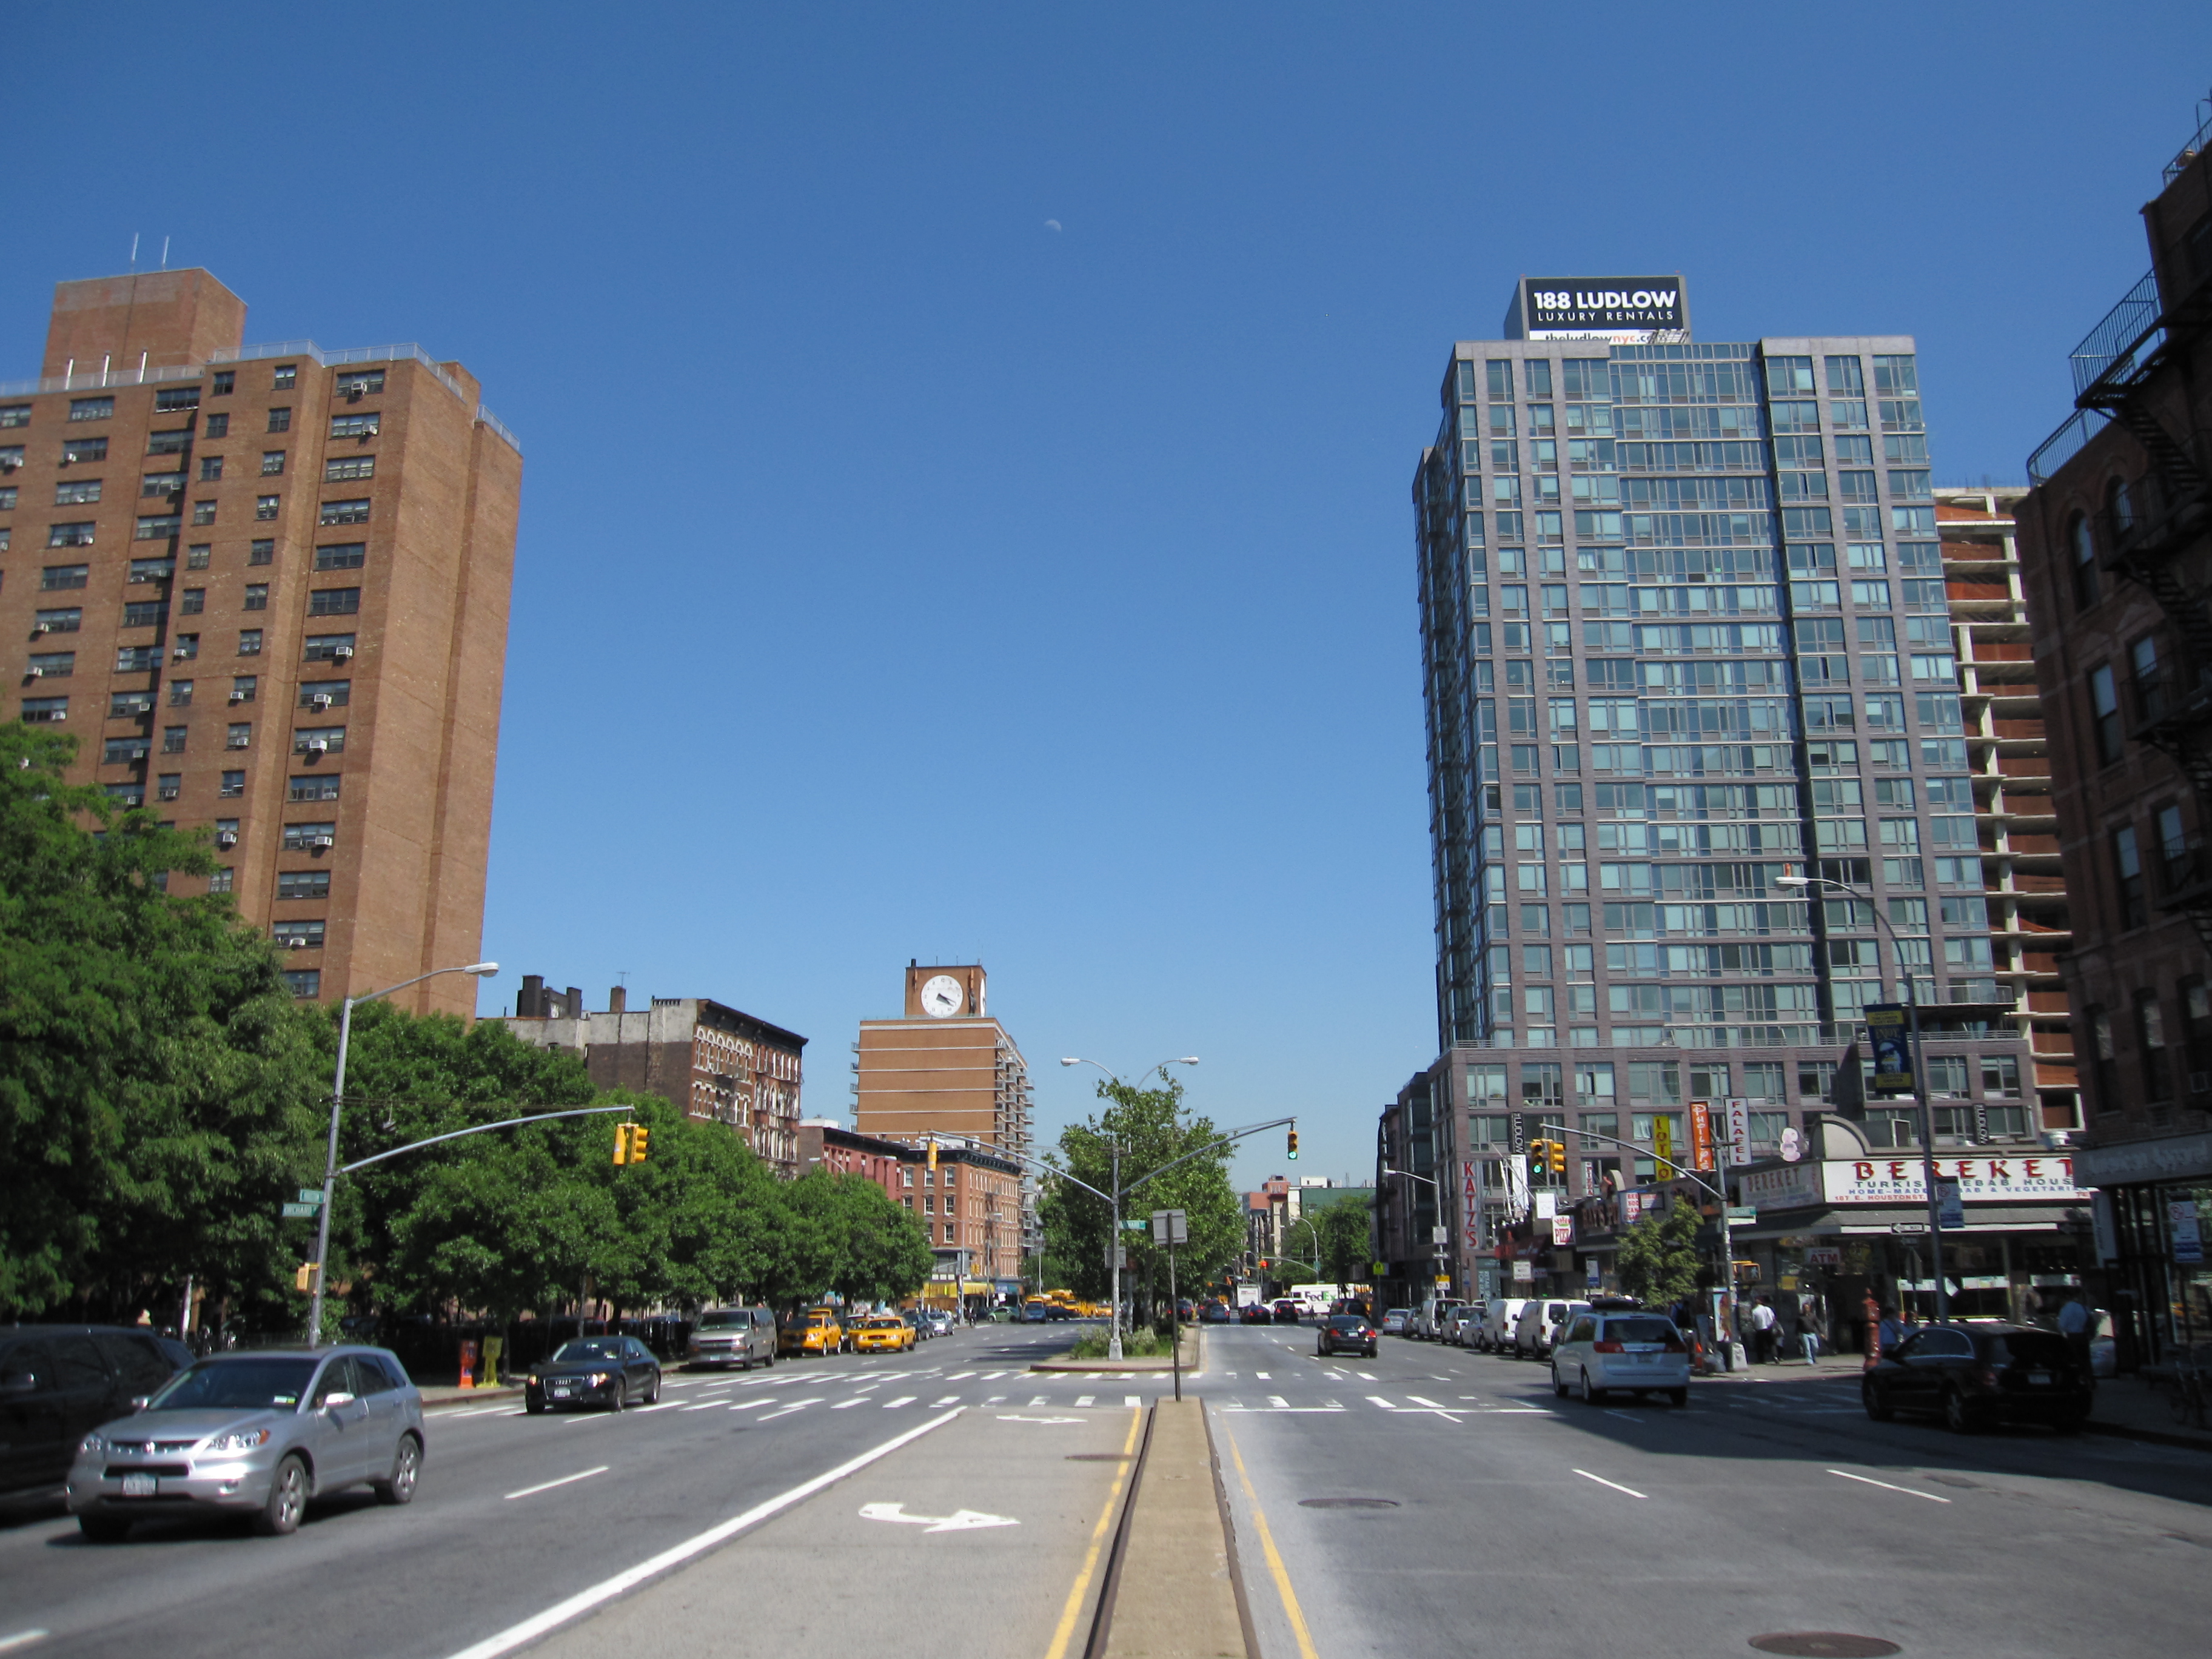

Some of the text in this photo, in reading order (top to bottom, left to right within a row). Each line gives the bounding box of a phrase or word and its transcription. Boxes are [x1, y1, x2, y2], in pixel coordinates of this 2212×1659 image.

[1534, 290, 1677, 309] 188 LUDLOW
[1538, 310, 1674, 321] LUXURY RENTALS
[1545, 332, 1655, 345] theludlownyc.c
[1514, 1118, 1523, 1154] LUDLOW
[1732, 1101, 1745, 1162] FALAFEL
[1656, 1119, 1669, 1178] LOTTO
[1747, 1167, 1800, 1192] BEREKET
[1852, 1159, 2073, 1181] BEREKET
[1464, 1161, 1477, 1247] KATZ'S
[1811, 1254, 1838, 1262] ATM
[1305, 1291, 1336, 1301] FedEx
